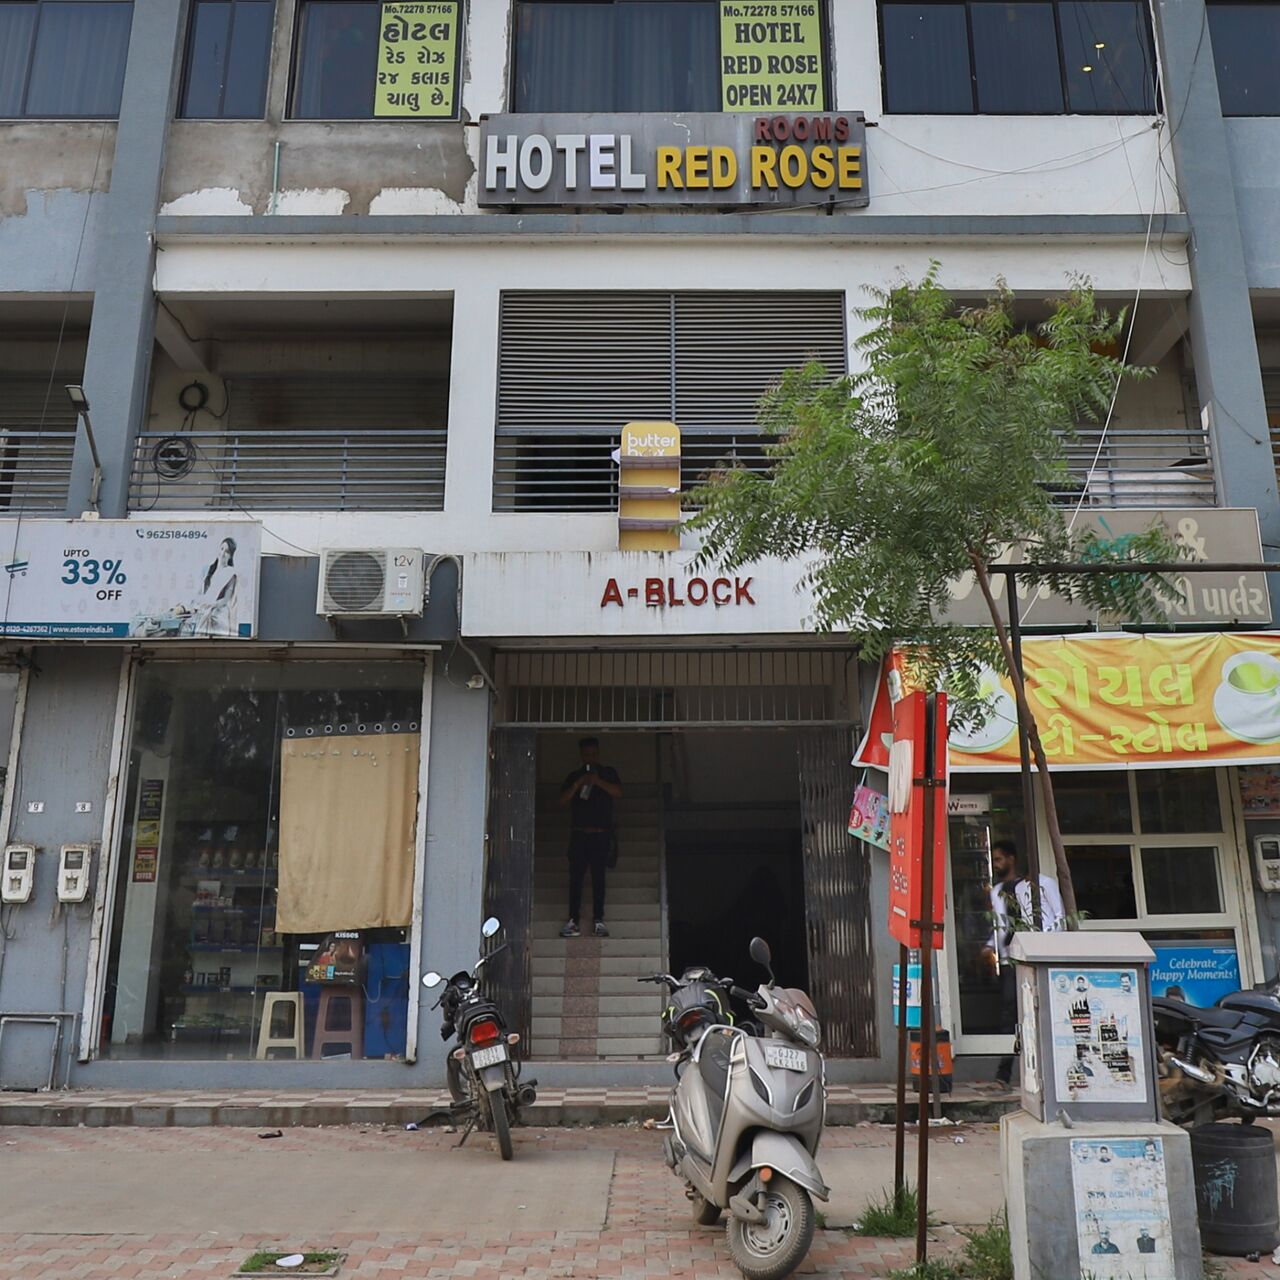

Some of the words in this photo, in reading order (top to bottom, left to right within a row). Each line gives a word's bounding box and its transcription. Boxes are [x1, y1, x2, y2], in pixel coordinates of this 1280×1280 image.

[780, 5, 815, 17] 57166
[383, 15, 450, 42] હોટલ
[735, 22, 804, 43] HOTEL
[385, 46, 405, 64] રેડ
[417, 46, 445, 64] રોઝ
[723, 55, 762, 74] RED
[767, 55, 818, 74] ROSE
[411, 72, 450, 85] કલાક
[387, 93, 420, 111] ચાલુ
[726, 84, 772, 106] OPEN
[777, 84, 817, 106] 24X7
[754, 116, 850, 142] ROOMS
[485, 135, 646, 191] HOTEL
[657, 146, 738, 189] RED
[751, 145, 863, 189] ROSE
[628, 432, 676, 447] butter
[146, 530, 208, 539] 9625184894
[61, 559, 127, 585] 33%
[96, 590, 122, 600] OFF
[600, 577, 756, 607] A-BLOCK
[1202, 576, 1266, 615] પાર્લર
[1033, 648, 1195, 708] રોયલ
[1169, 958, 1217, 969] Celebrate
[1152, 969, 1185, 982] Happy
[1187, 969, 1237, 980] Moments!
